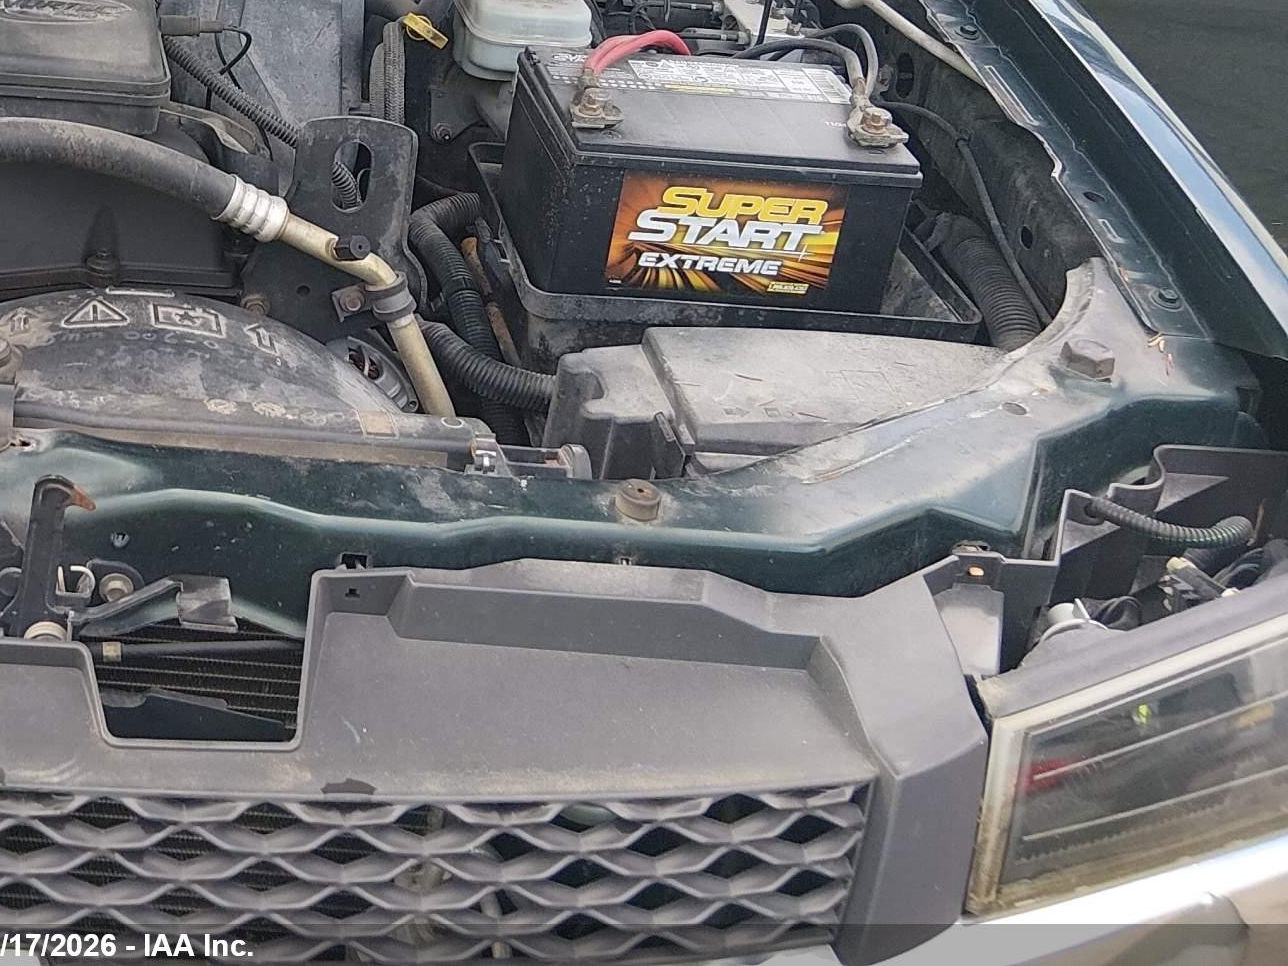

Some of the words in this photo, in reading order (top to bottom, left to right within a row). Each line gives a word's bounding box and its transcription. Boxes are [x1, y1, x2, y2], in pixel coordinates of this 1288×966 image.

[658, 186, 828, 223] SUPER
[628, 209, 823, 251] START
[638, 252, 782, 275] EXTREME
